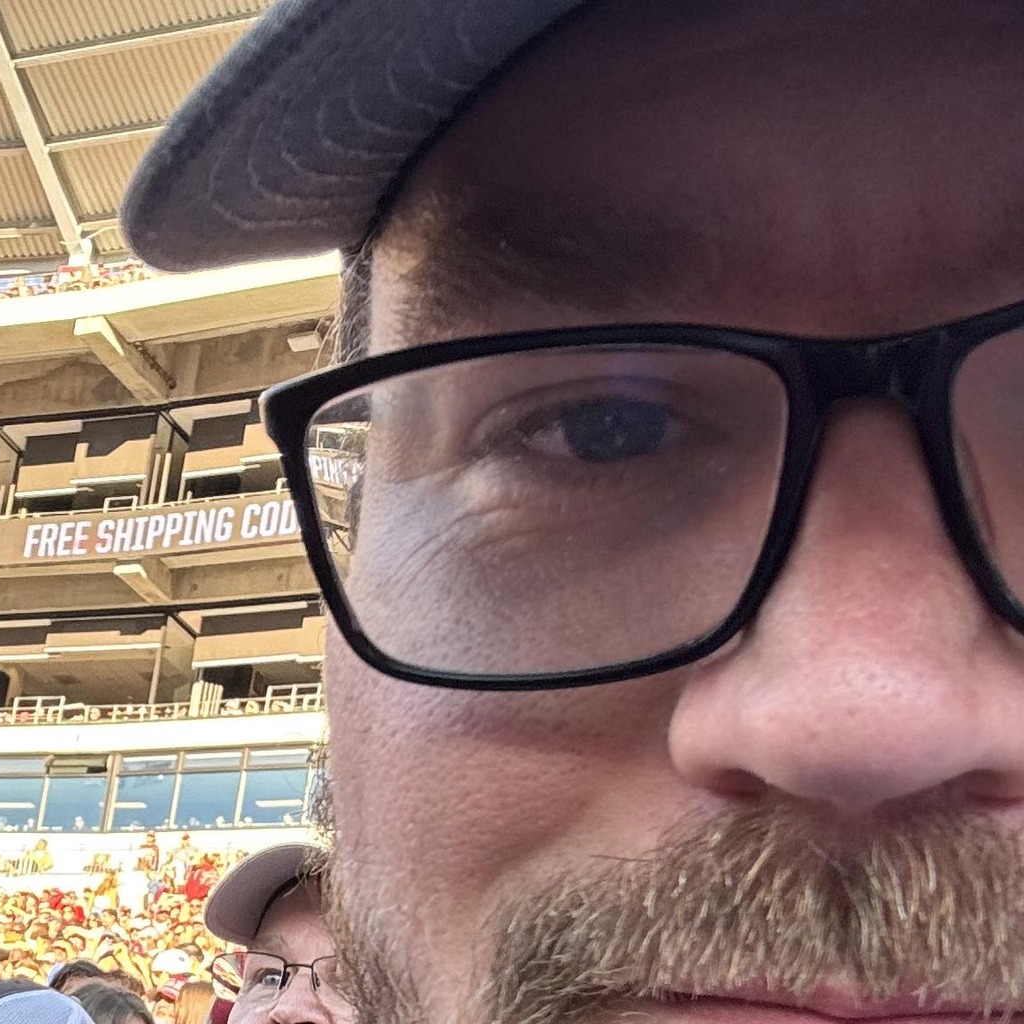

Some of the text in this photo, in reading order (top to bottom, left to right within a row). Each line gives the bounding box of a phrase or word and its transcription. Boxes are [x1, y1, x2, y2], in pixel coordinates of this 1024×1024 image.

[24, 499, 301, 557] FREE SHIPPING COD
